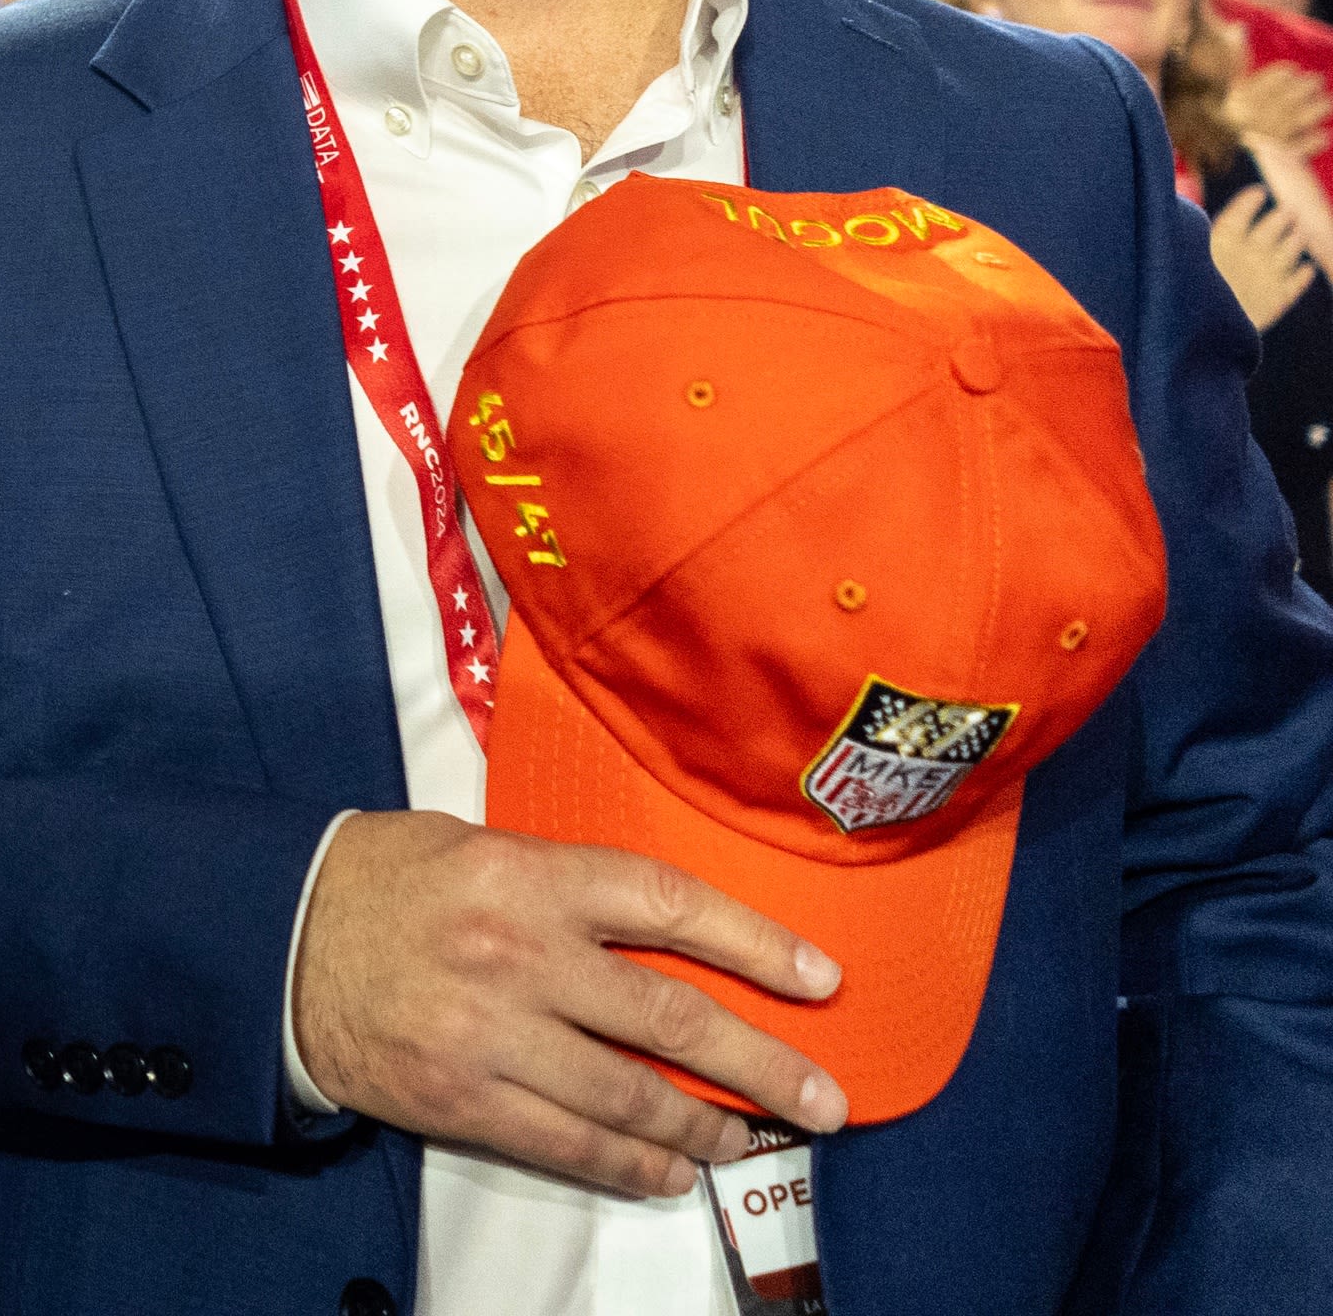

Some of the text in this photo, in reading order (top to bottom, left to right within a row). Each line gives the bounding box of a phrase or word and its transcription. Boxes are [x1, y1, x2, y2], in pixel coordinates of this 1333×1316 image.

[306, 107, 340, 166] DATA
[700, 191, 969, 250] MOGUL
[399, 400, 449, 539] RNC2024
[846, 750, 952, 790] MKE
